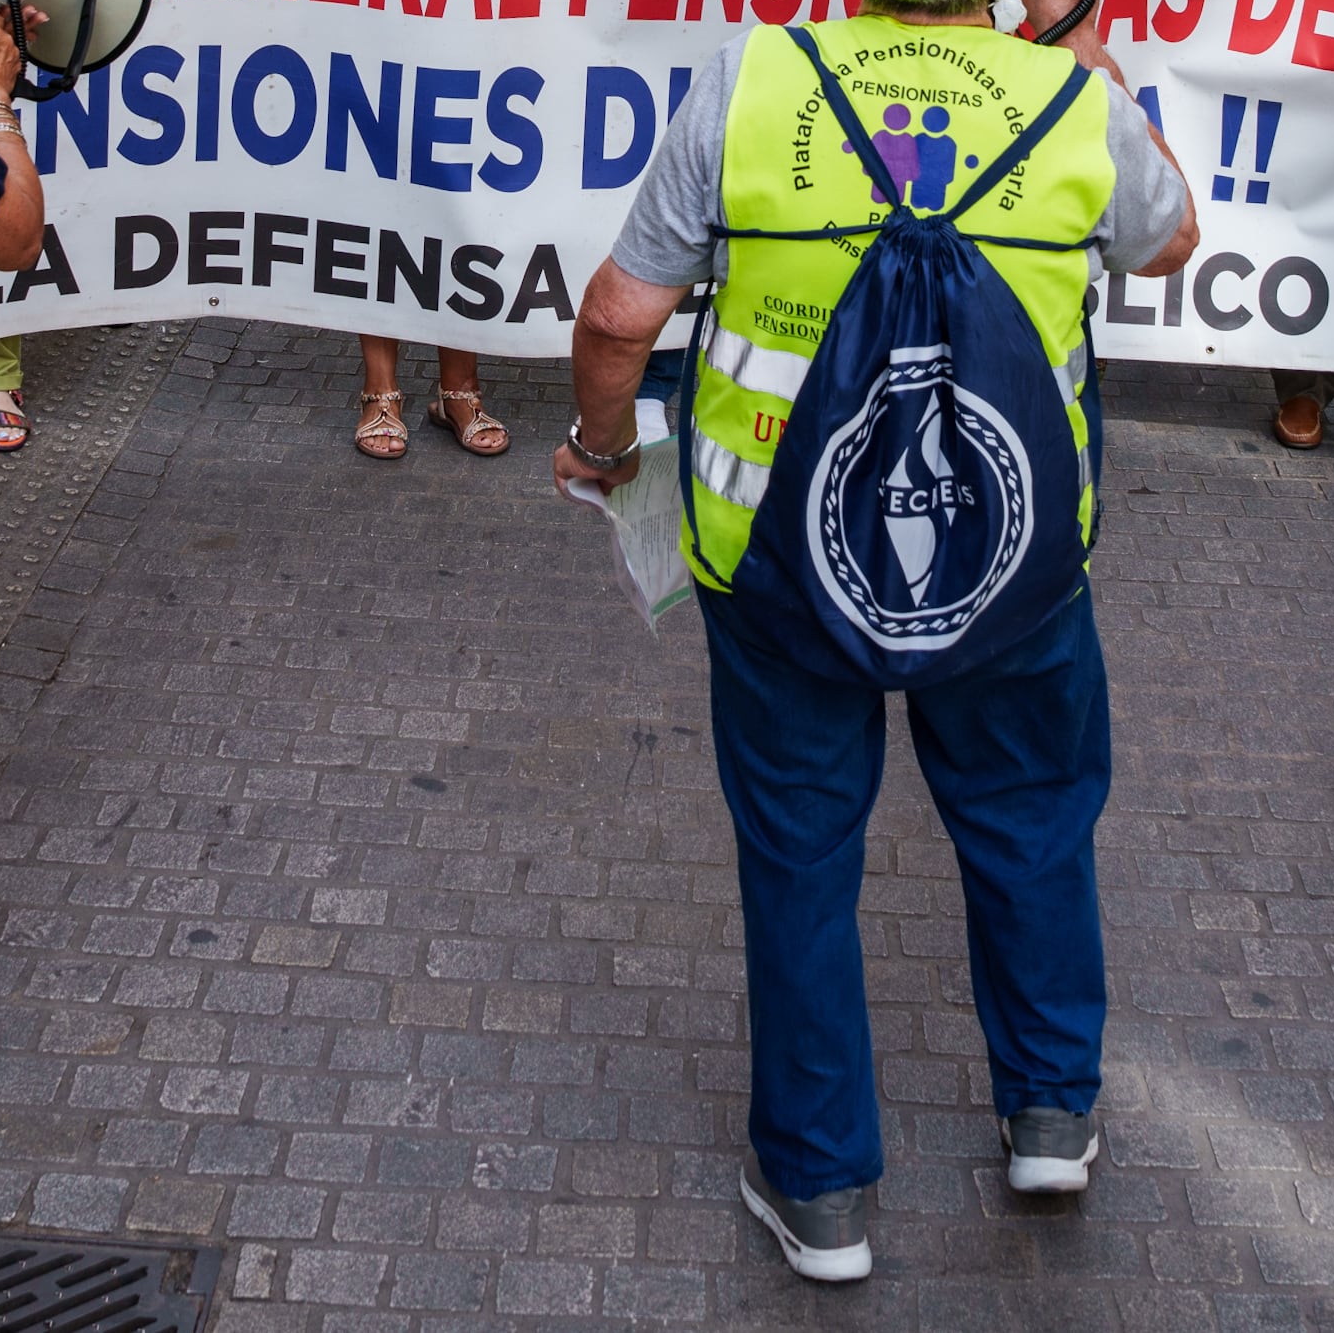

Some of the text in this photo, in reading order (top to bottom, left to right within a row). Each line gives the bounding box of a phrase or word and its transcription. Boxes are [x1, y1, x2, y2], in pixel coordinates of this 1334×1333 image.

[15, 44, 545, 195] NSIONES
[792, 37, 1032, 212] Platafora Pensionistas de arla
[852, 79, 983, 108] PENSIONISTAS
[113, 211, 576, 323] DEFENSA
